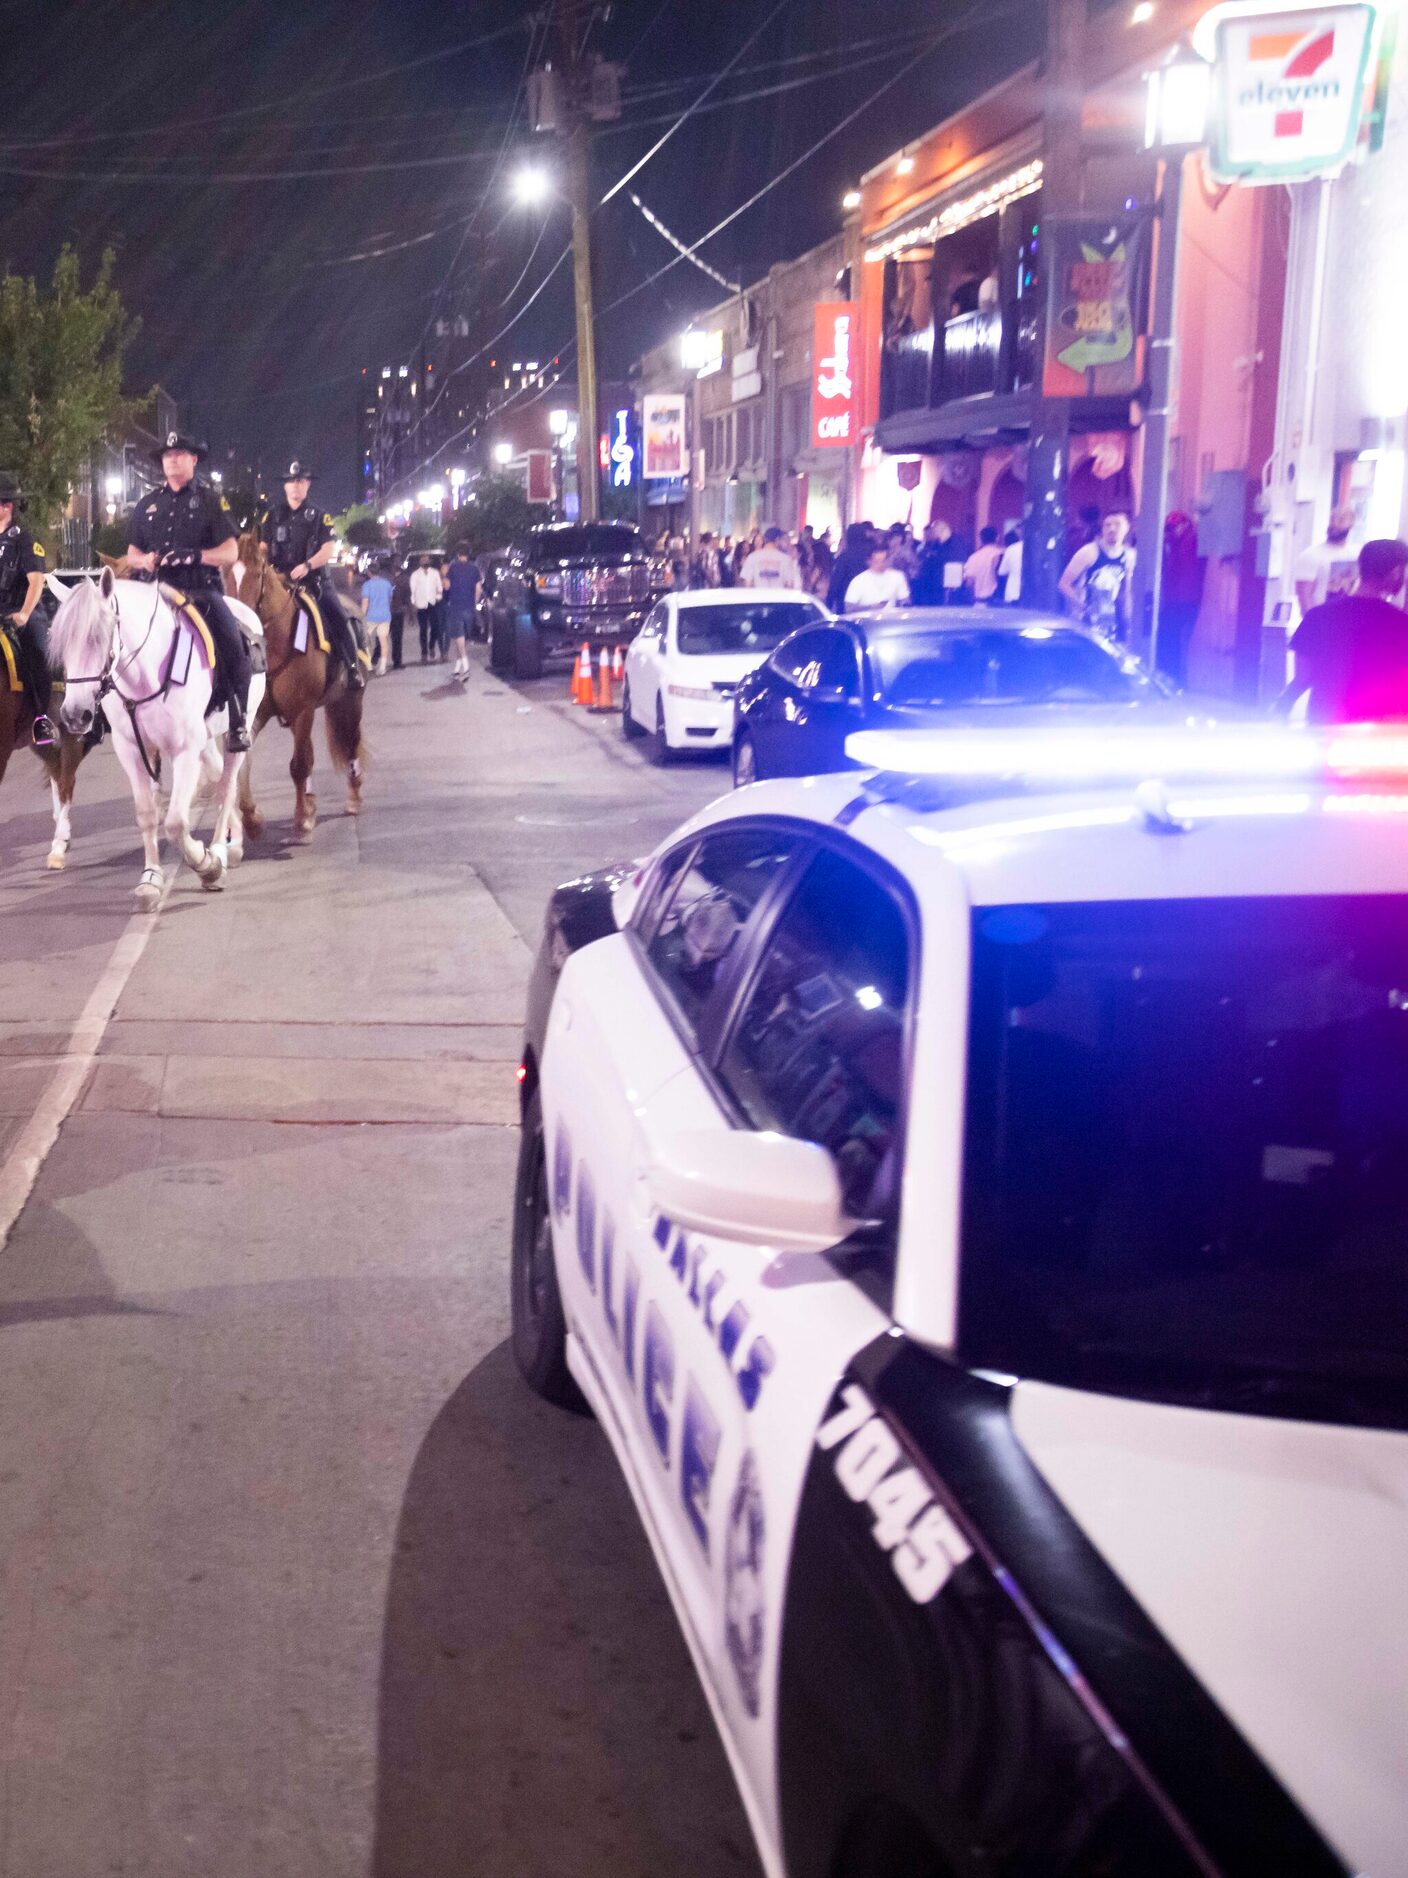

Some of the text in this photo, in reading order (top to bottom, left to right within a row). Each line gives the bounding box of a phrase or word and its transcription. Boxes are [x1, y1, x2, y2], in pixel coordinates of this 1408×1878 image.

[1238, 79, 1341, 105] eleven
[553, 1112, 724, 1567] POLICE
[814, 1383, 975, 1606] 7045
